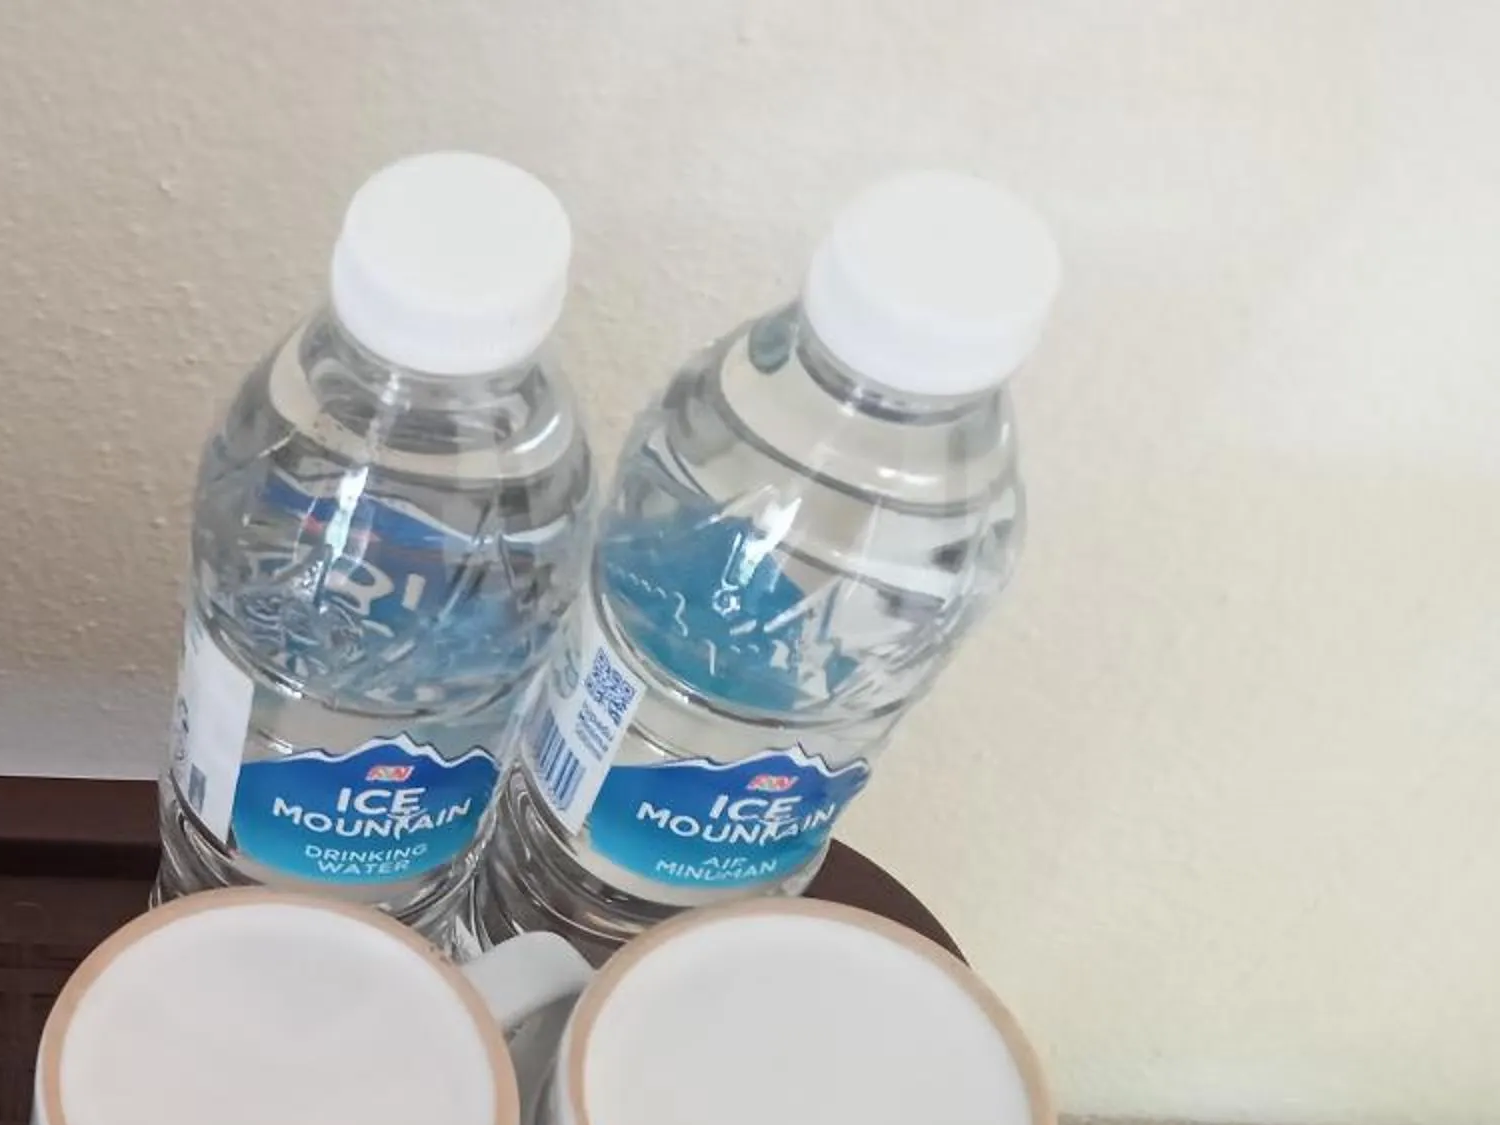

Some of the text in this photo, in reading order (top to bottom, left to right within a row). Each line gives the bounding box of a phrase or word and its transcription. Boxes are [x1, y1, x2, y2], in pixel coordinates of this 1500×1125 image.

[337, 787, 426, 815] ICE
[709, 795, 803, 821] ICE
[272, 797, 472, 840] MOUNTAIN
[636, 801, 836, 846] MOUNTAIN
[304, 843, 428, 863] DRINKING
[317, 859, 410, 875] WATER
